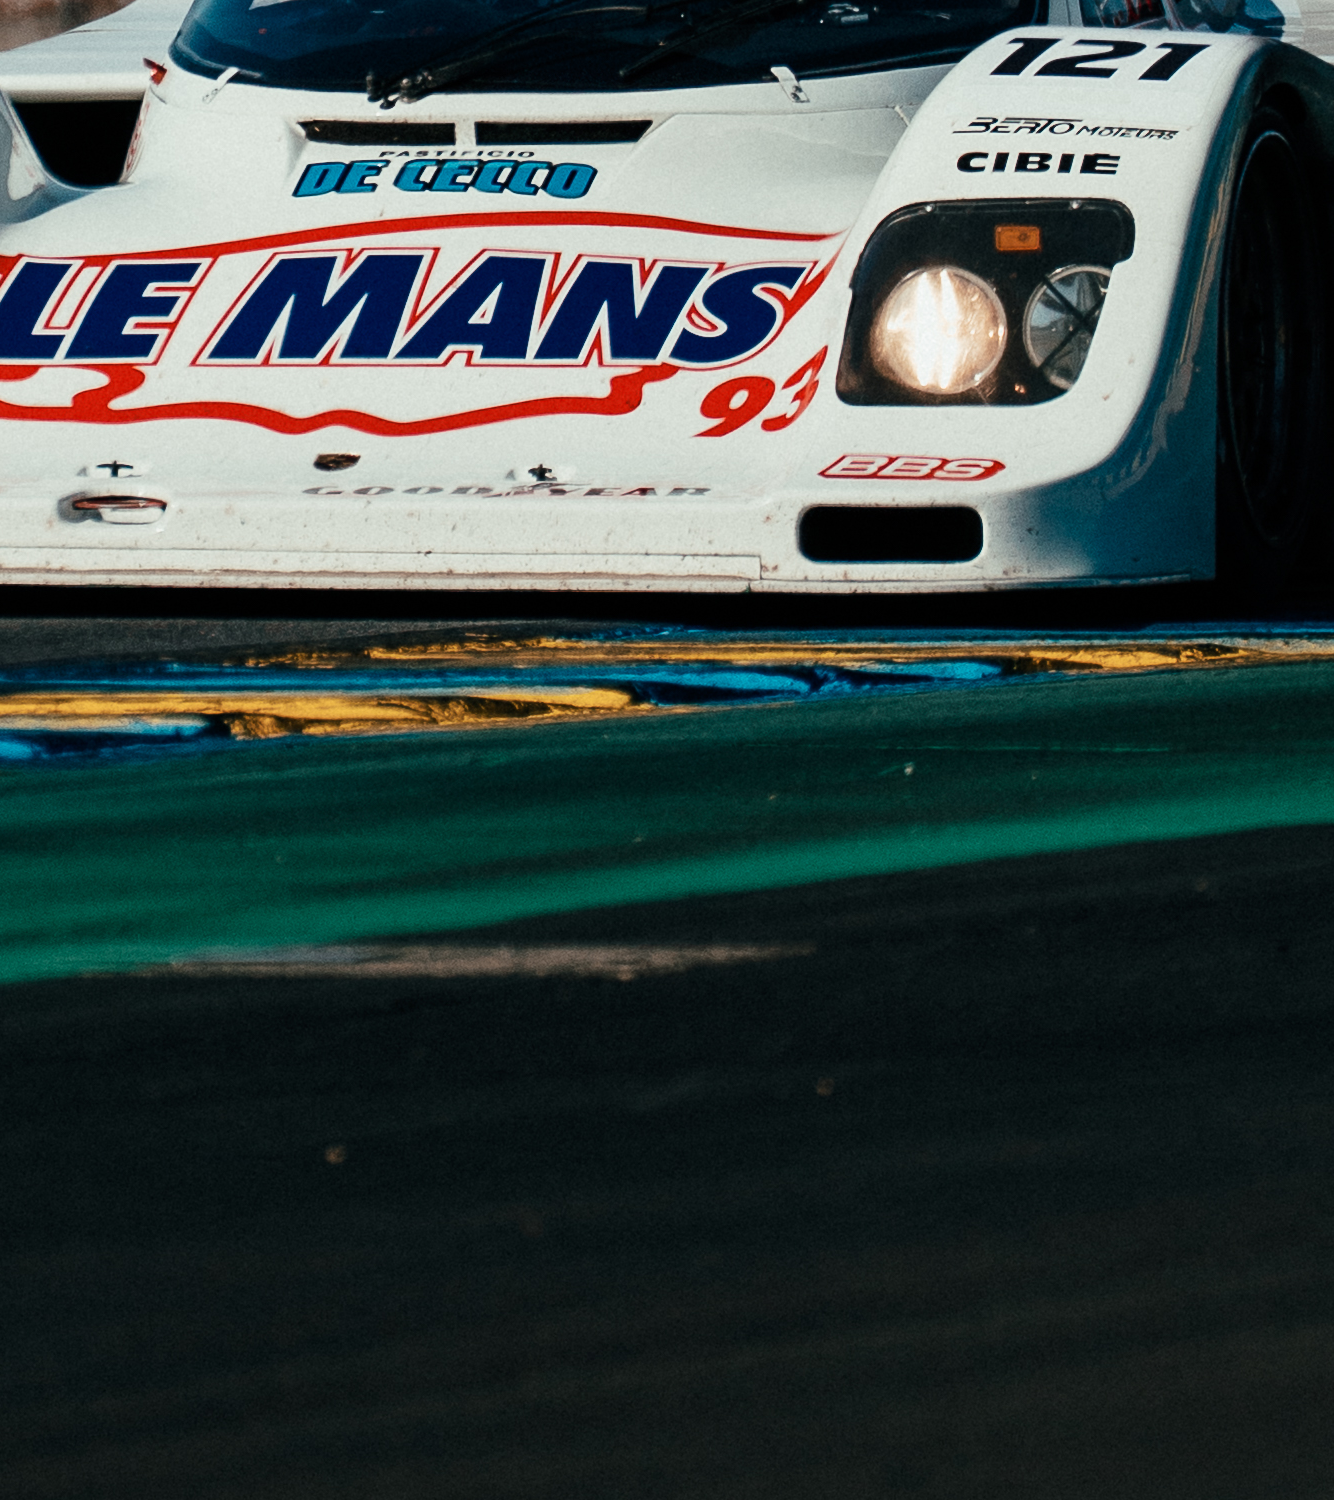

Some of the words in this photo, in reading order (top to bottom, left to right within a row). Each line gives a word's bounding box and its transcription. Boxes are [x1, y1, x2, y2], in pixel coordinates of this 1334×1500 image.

[989, 37, 1211, 81] 121
[952, 117, 1083, 135] BERTO
[1076, 126, 1179, 140] MOTEURS
[378, 150, 535, 158] PASTIFICIO
[292, 159, 391, 198] DE
[392, 158, 598, 199] CECCO
[202, 250, 815, 369] MANS
[817, 455, 1006, 482] BBS
